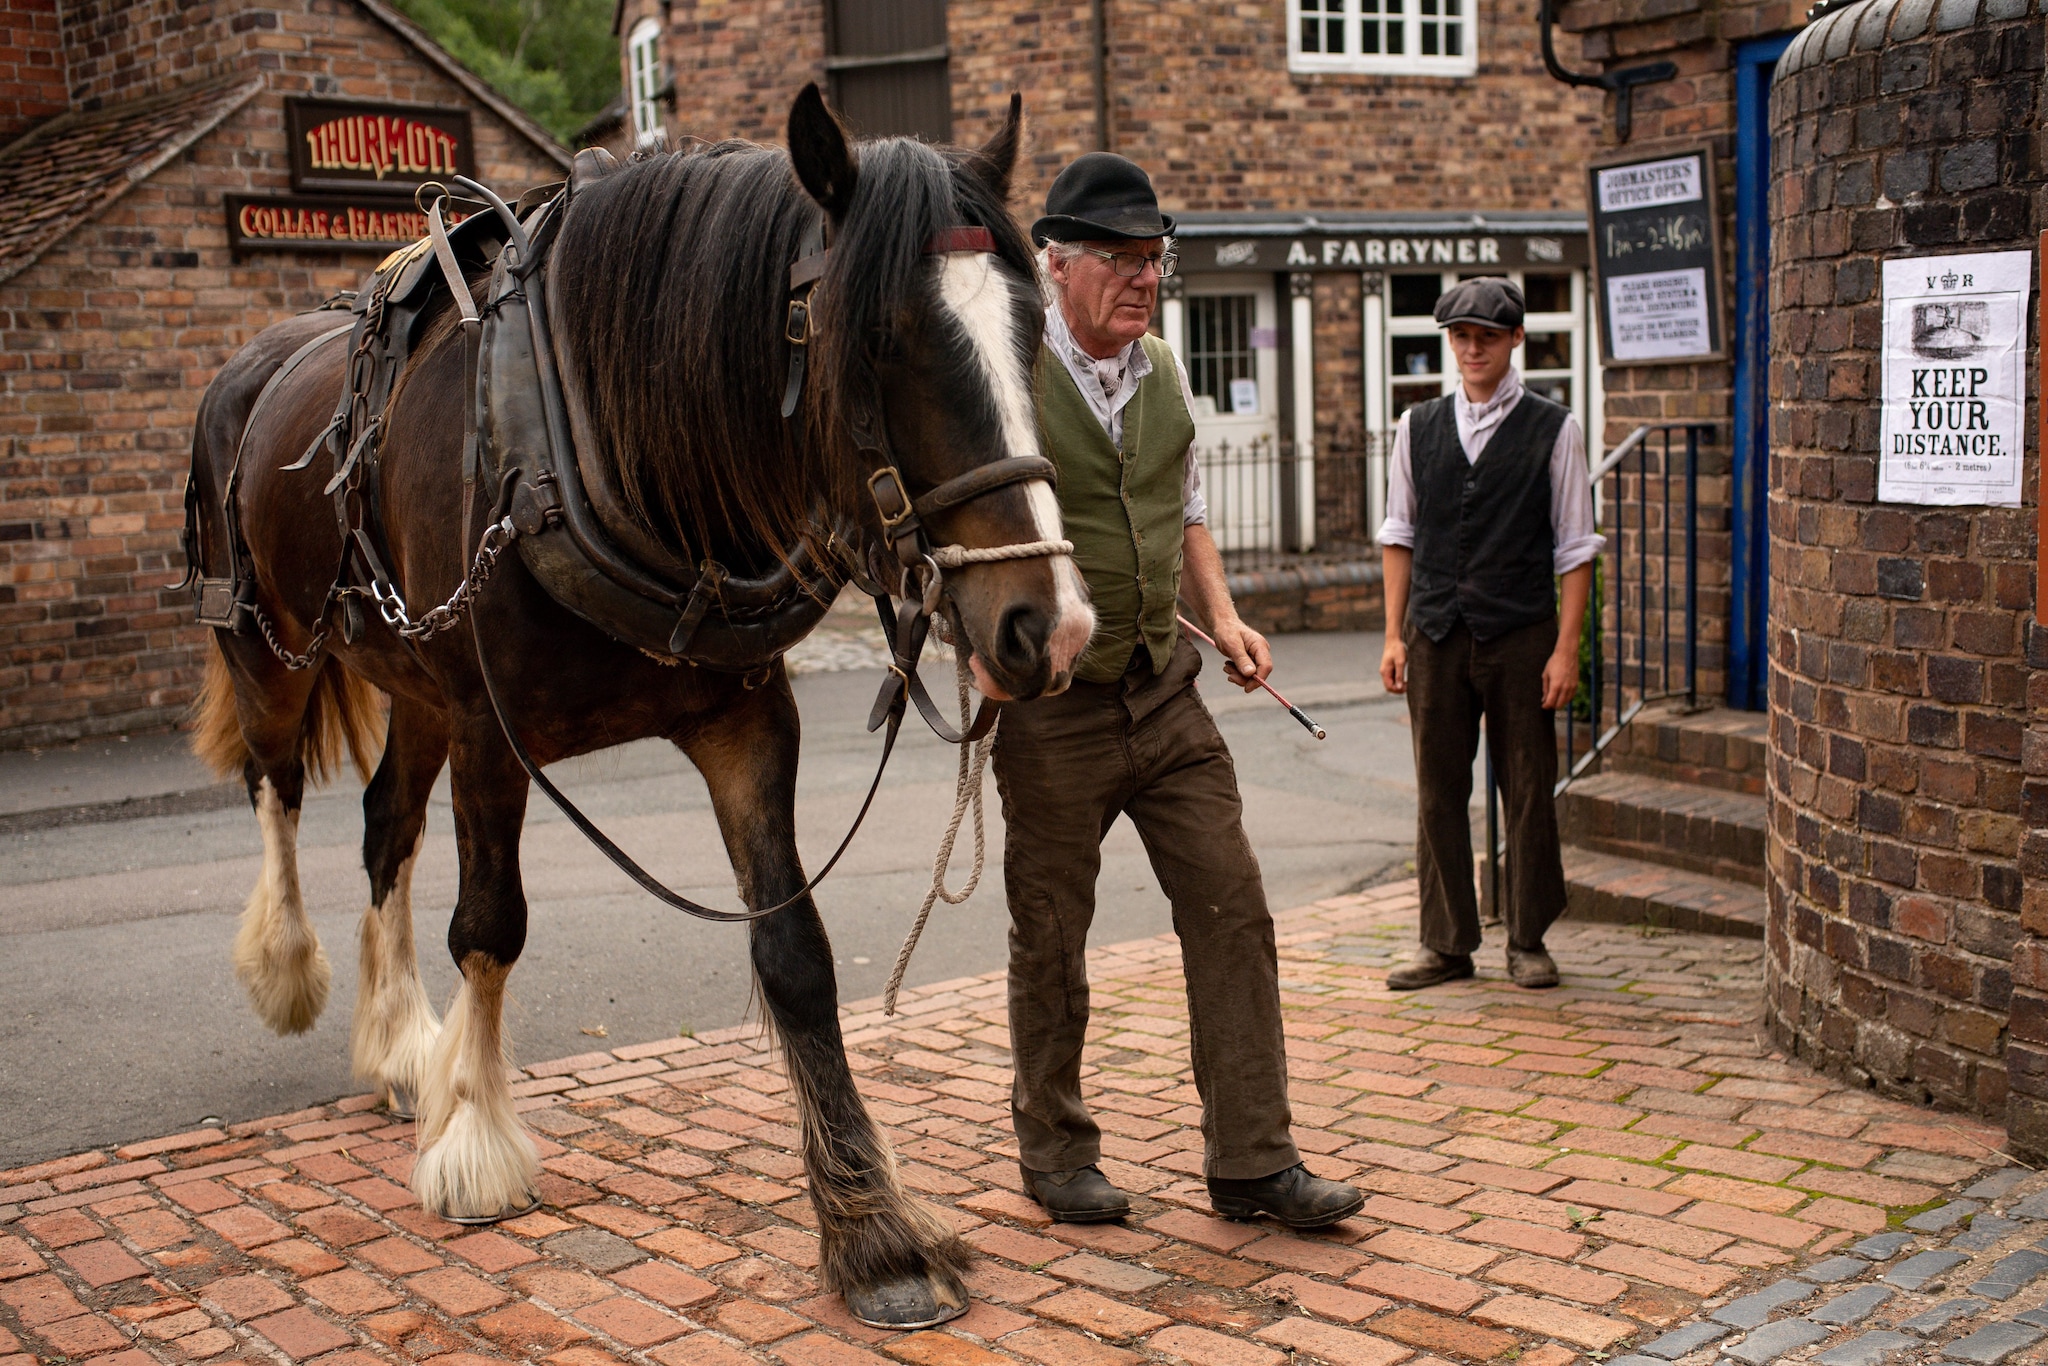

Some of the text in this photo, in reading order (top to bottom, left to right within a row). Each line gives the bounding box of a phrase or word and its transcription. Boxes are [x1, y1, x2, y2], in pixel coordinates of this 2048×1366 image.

[306, 115, 458, 180] THURMOTT
[1608, 186, 1652, 205] OFFICE
[239, 204, 430, 242] COLLAR & HARNE
[1286, 240, 1316, 265] A.
[1322, 238, 1500, 265] FARRYNER
[1926, 273, 1974, 289] V R
[1911, 368, 1988, 398] KEEP
[1909, 400, 1990, 430] YOUR
[1893, 433, 2007, 457] DISTANCE.
